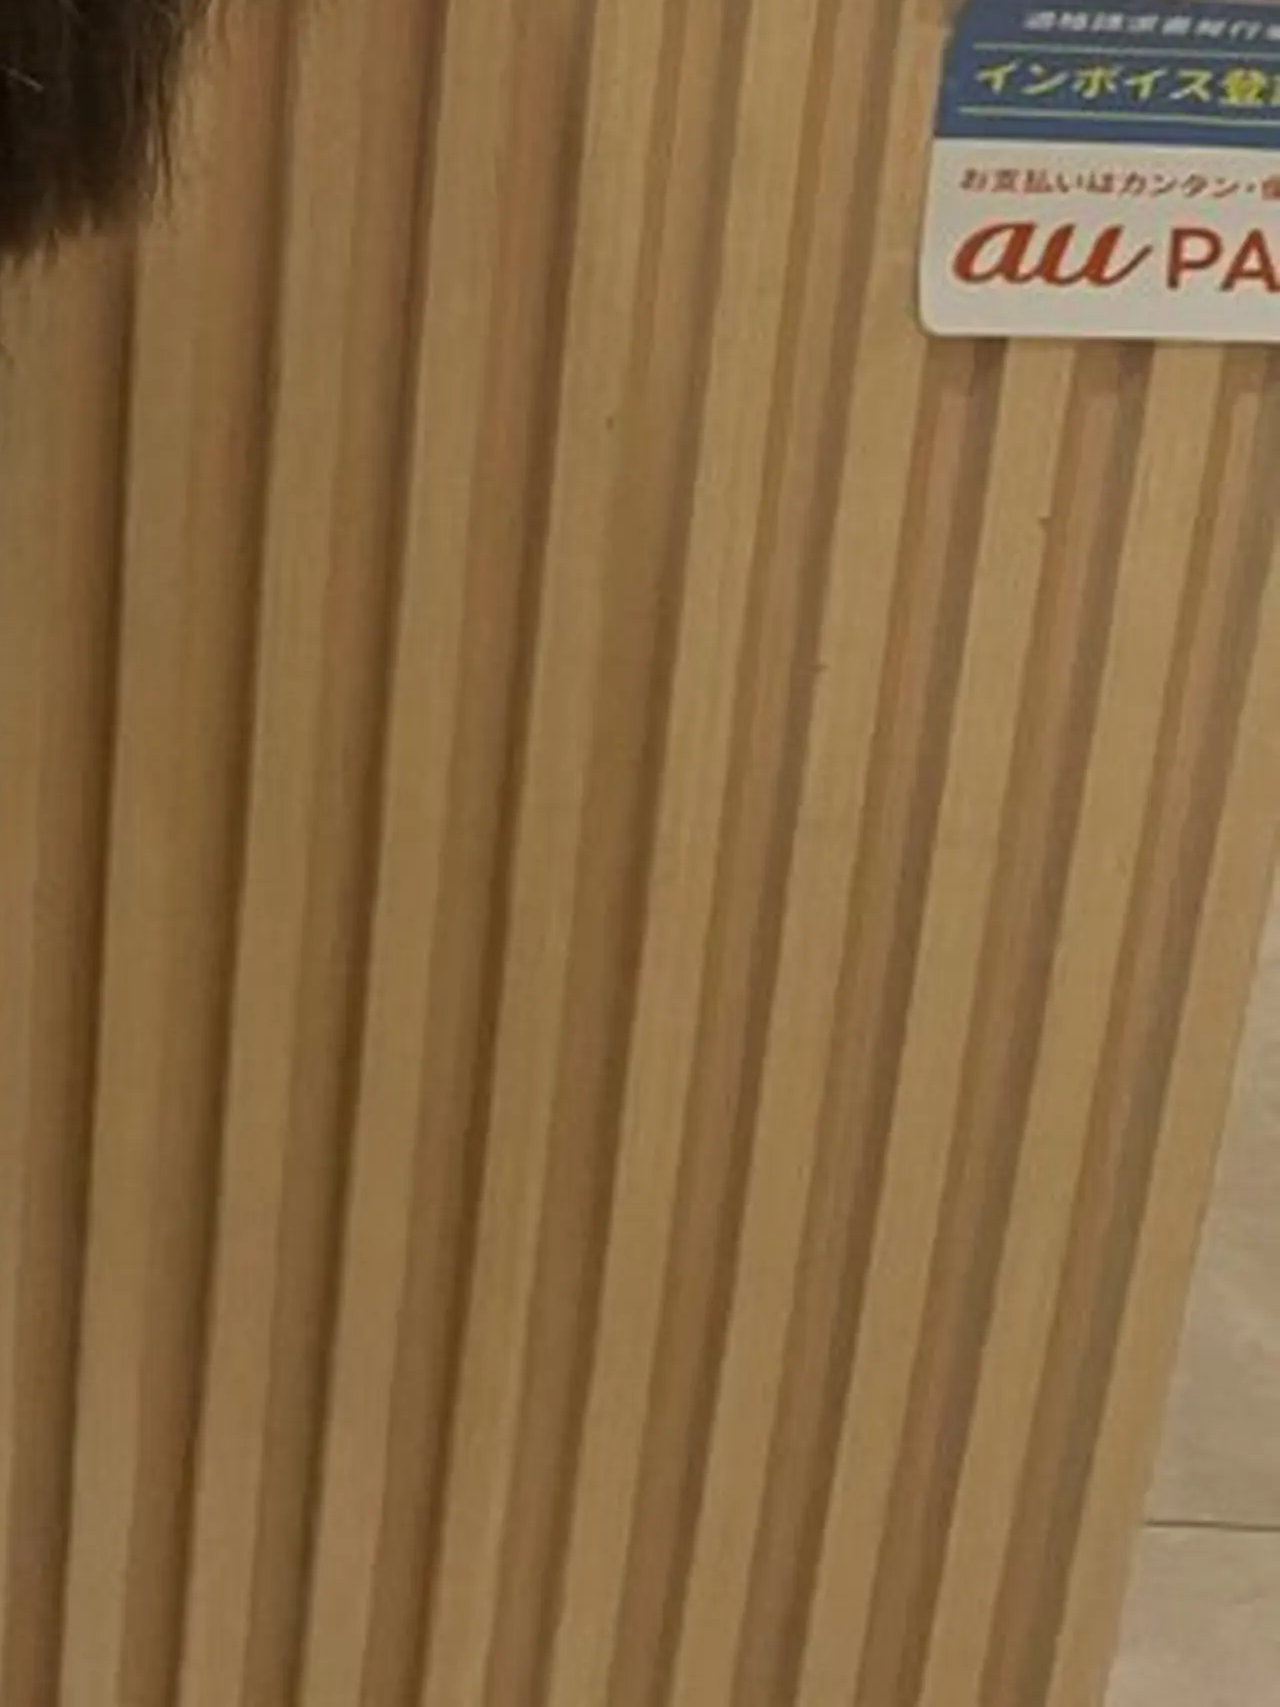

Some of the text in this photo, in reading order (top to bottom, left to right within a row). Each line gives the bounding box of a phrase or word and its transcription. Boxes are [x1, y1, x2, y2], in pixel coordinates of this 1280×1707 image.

[975, 59, 1280, 108] インボイス登
[952, 219, 1153, 287] au
